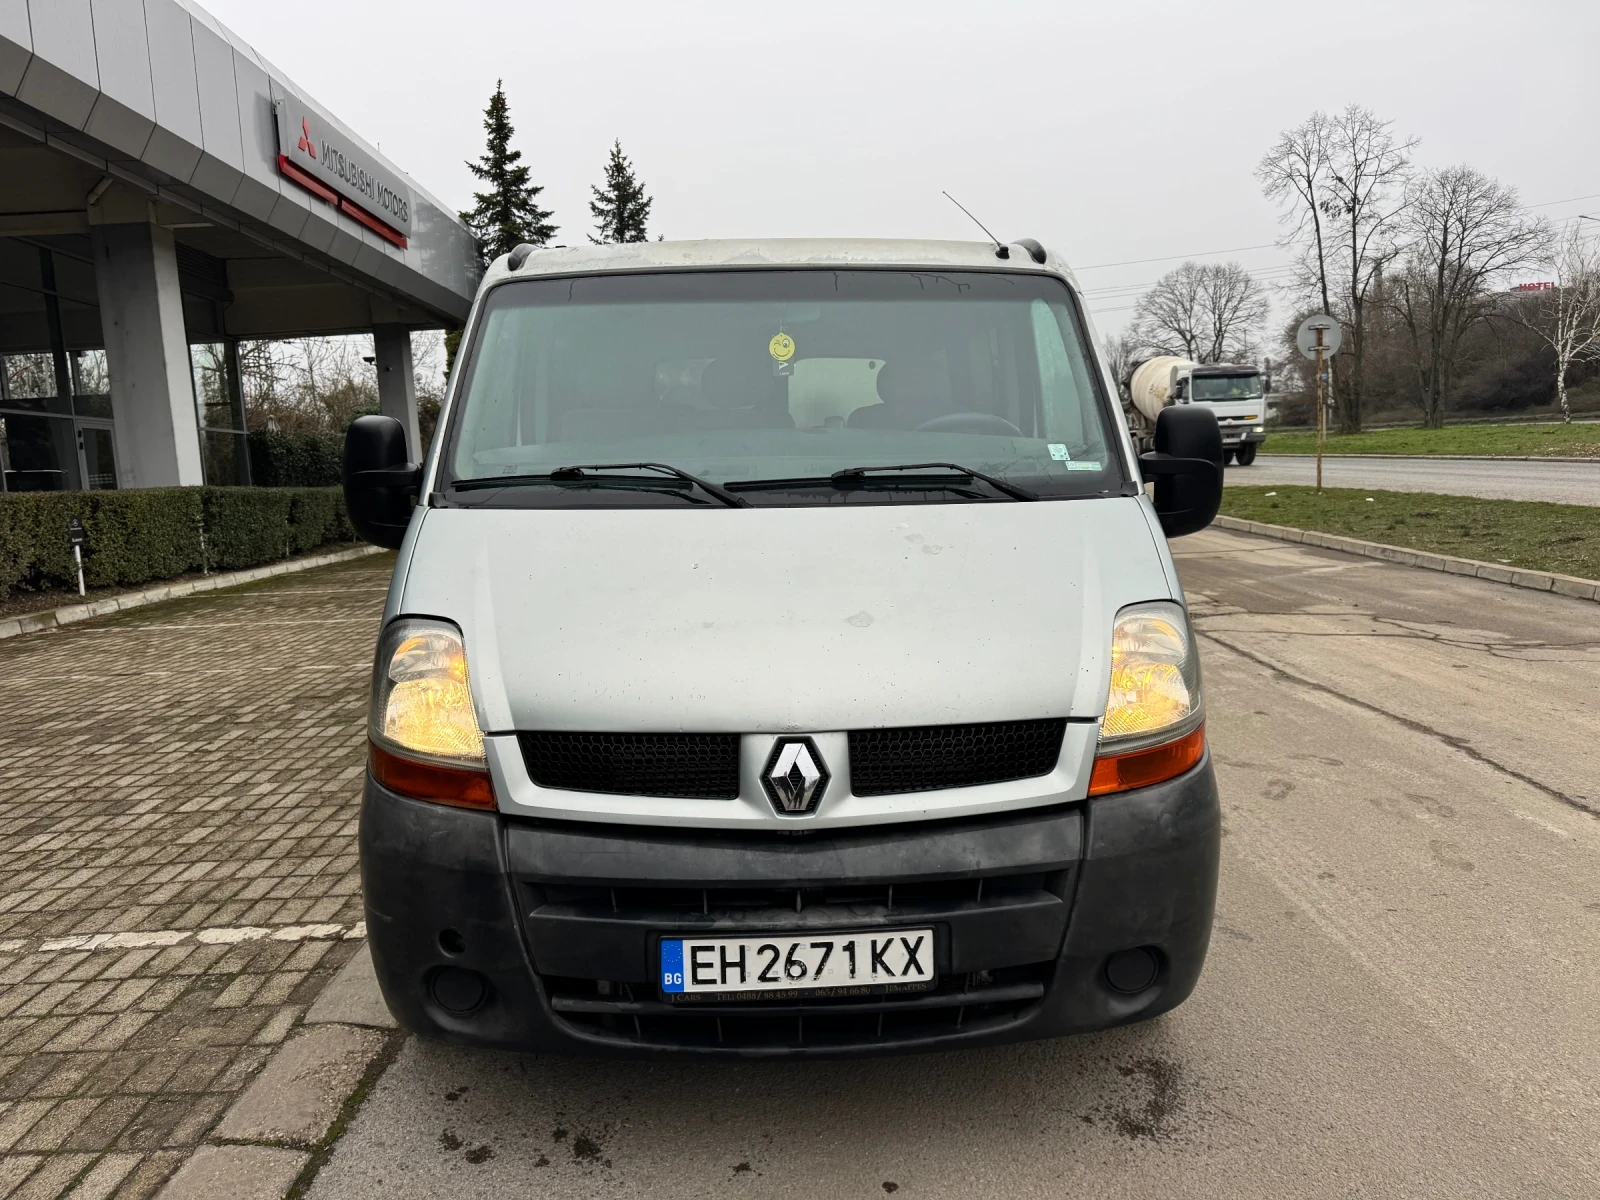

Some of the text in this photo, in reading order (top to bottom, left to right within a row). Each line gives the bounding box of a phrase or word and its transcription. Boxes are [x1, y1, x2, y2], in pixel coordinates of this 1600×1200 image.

[320, 139, 409, 223] MITSUBISHI MOTORS
[664, 973, 682, 985] BG
[677, 993, 701, 1001] CARS
